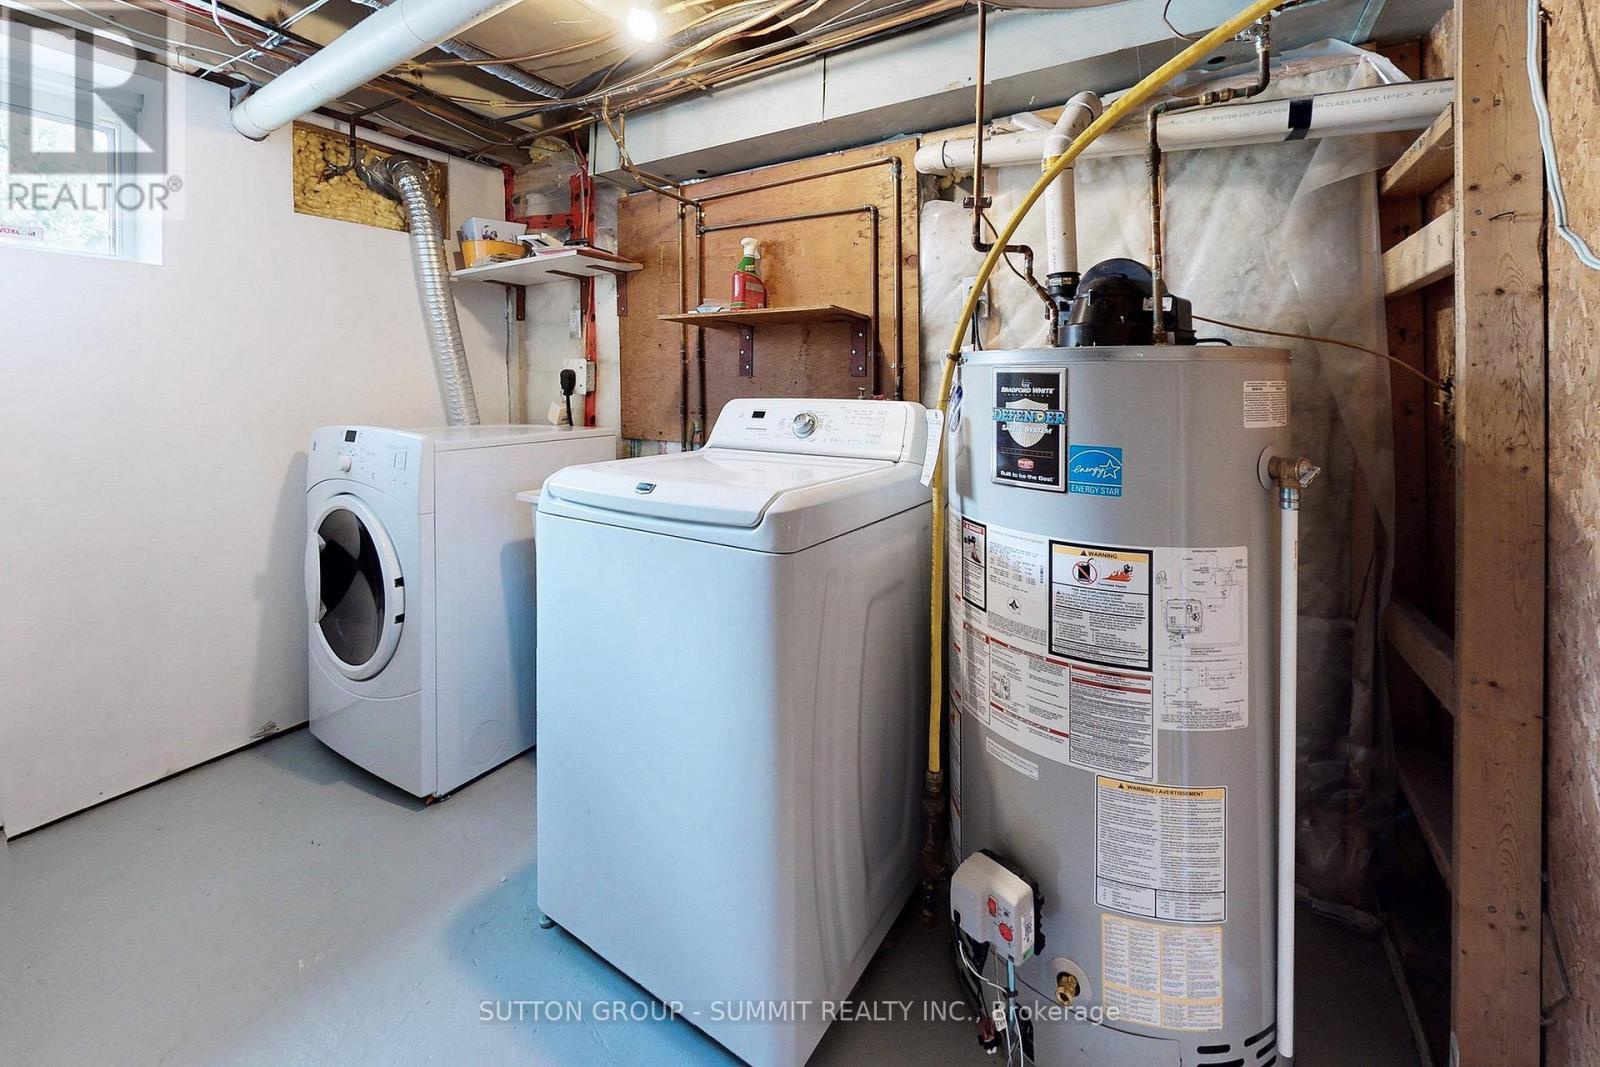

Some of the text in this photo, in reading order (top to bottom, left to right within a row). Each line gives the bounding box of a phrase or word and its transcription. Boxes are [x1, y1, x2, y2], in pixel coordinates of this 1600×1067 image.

[1000, 386, 1032, 394] BRADFORD
[1032, 387, 1054, 395] WHITE
[992, 407, 1067, 425] DEFENDER
[1000, 470, 1012, 478] Built
[1071, 484, 1120, 496] ENERGY STAR
[1088, 551, 1118, 560] WARNING
[1127, 785, 1155, 795] WARNING
[1158, 788, 1204, 797] AVERTISSEMENT
